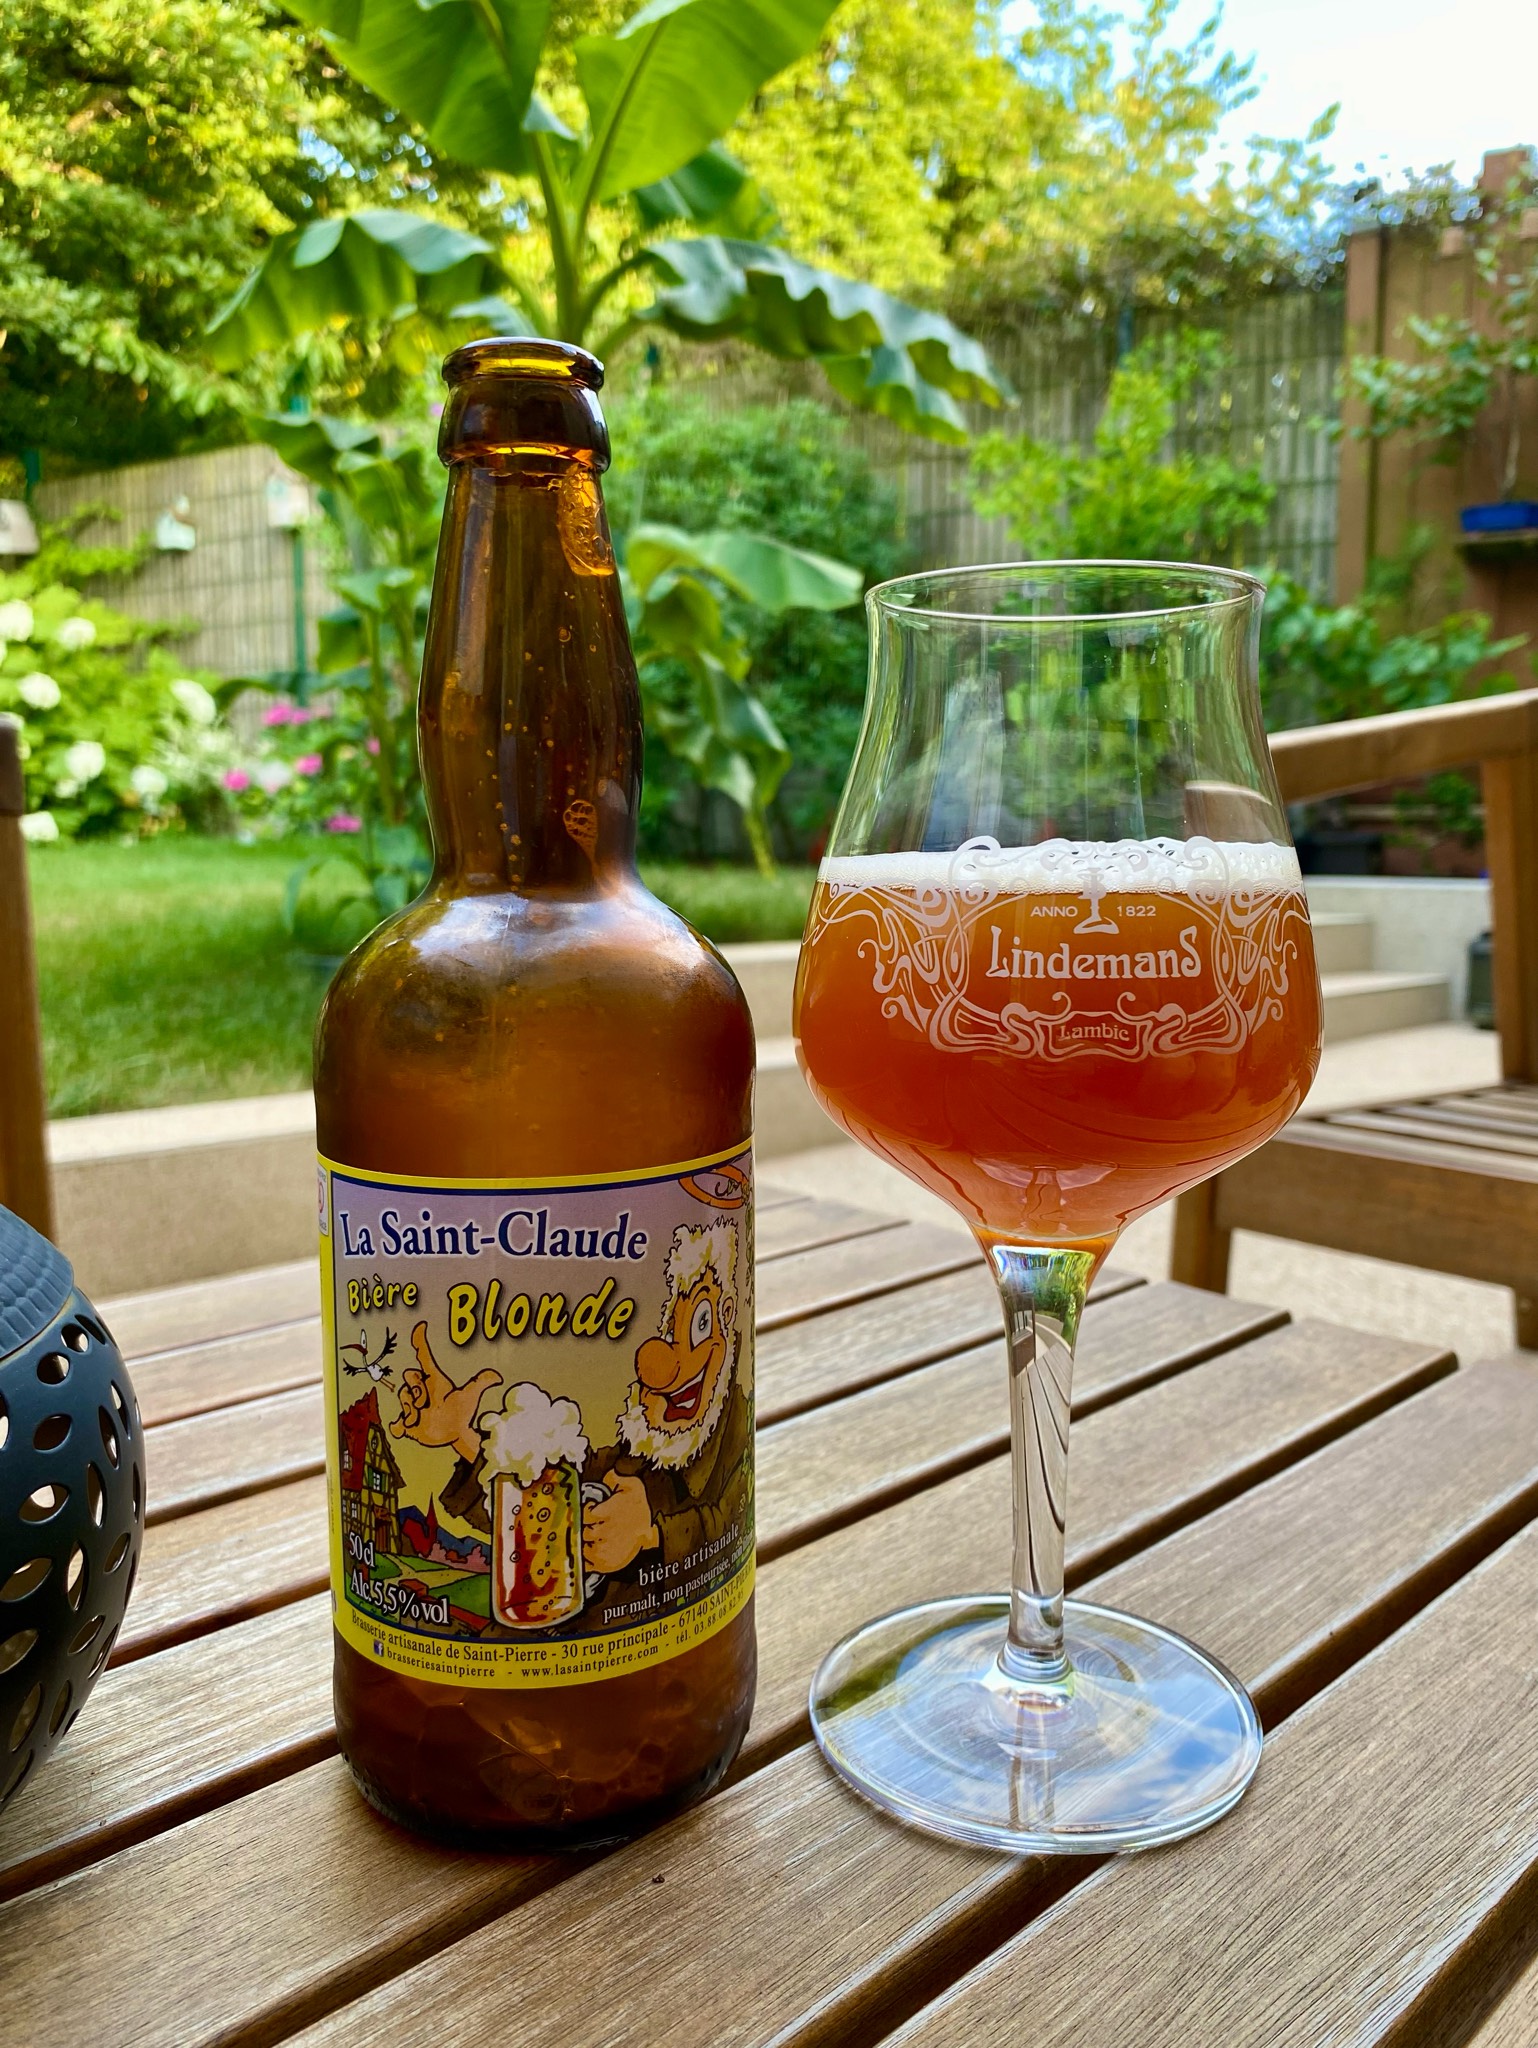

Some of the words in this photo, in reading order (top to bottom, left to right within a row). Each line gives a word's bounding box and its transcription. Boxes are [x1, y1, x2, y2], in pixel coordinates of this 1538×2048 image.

[1030, 906, 1079, 918] ANNO
[1117, 905, 1156, 917] 1822
[1059, 1022, 1130, 1042] Lambic
[340, 1212, 375, 1257] La
[381, 1207, 648, 1261] Saint-Claude
[347, 1274, 419, 1314] Bière
[447, 1275, 638, 1347] Blonde
[639, 1561, 680, 1586] bière
[684, 1523, 739, 1570] artisanale
[603, 1604, 627, 1624] pur
[632, 1590, 661, 1613] malt,
[662, 1584, 683, 1603] non
[684, 1557, 731, 1597] pasteurisée,
[351, 1609, 386, 1641] Brasserie
[388, 1633, 442, 1658] artisanale
[445, 1644, 460, 1659] de
[463, 1646, 547, 1662] Saint-Pierre
[561, 1644, 578, 1659] 30
[582, 1643, 604, 1656] rue
[608, 1622, 669, 1655] principale
[678, 1601, 708, 1628] 67140
[387, 1647, 495, 1678] brasseriesaintpierre
[521, 1645, 659, 1677] www.lasaintpierre.com
[676, 1629, 691, 1644] tél.
